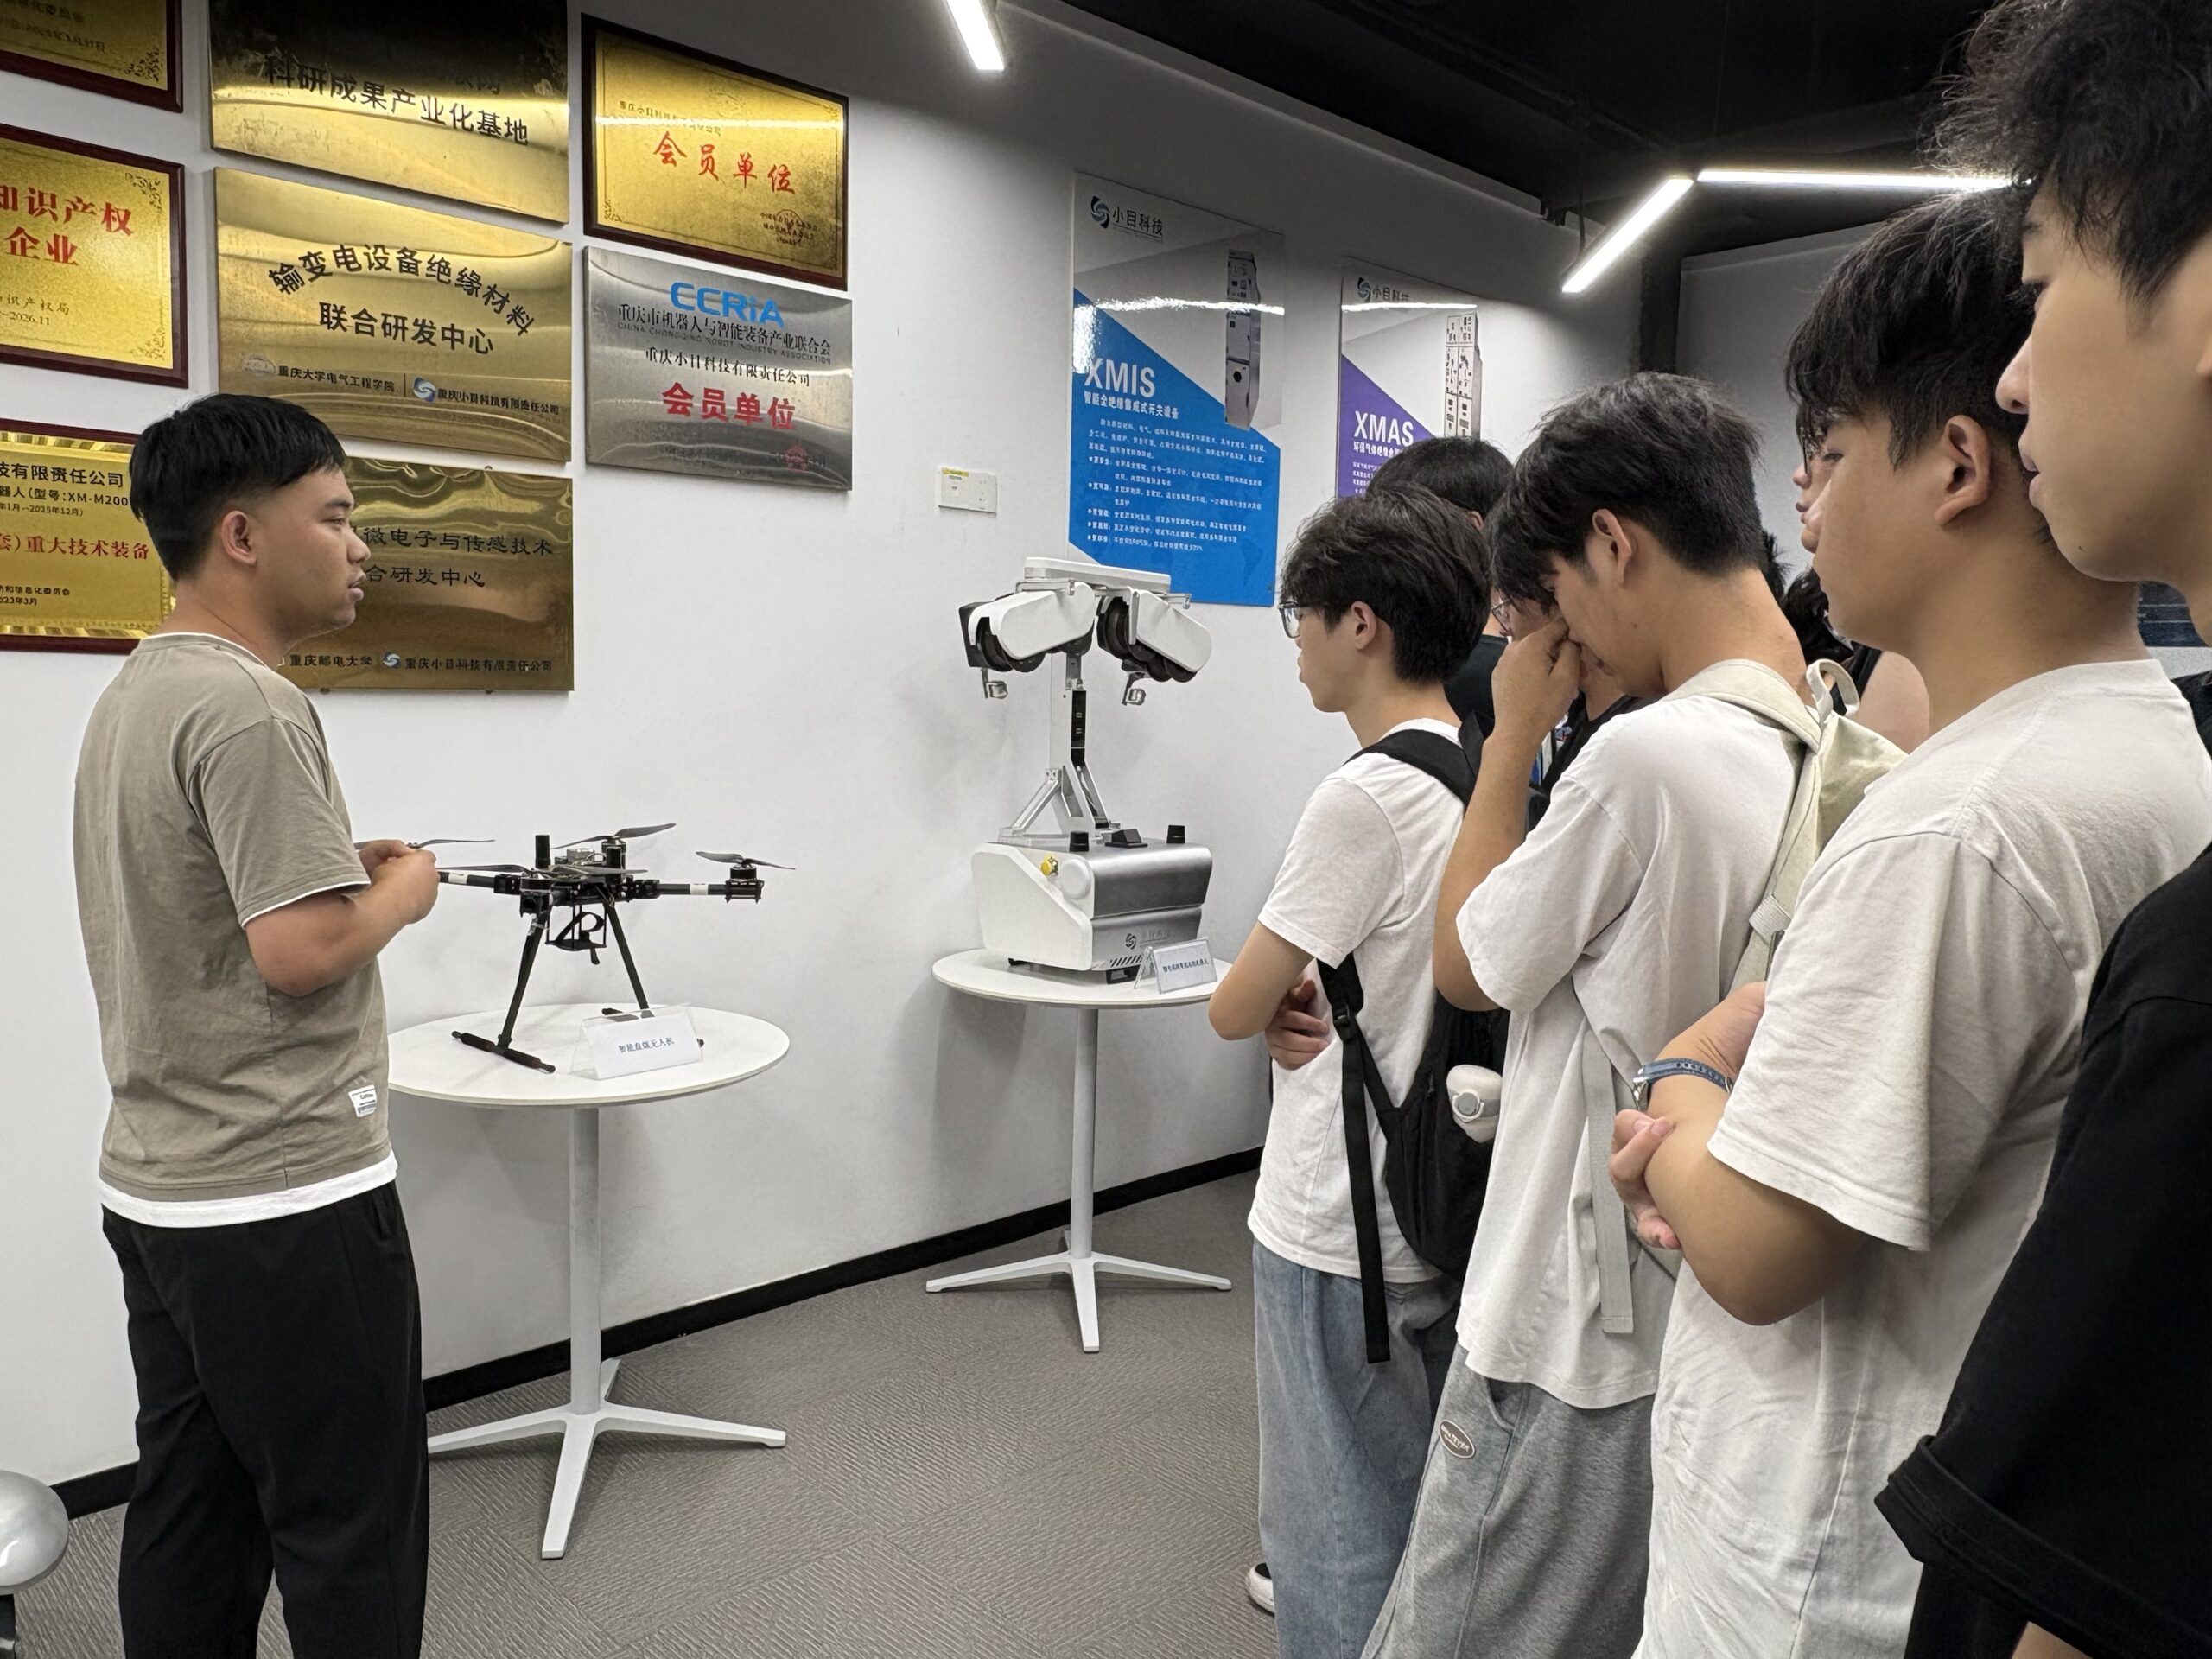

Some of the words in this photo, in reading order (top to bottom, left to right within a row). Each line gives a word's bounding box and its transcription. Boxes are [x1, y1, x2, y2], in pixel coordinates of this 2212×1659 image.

[262, 54, 529, 145] 科研成果产业化基地
[652, 130, 796, 194] 会员单位
[1112, 206, 1163, 237] 小目科技
[4, 226, 79, 266] 企业
[0, 294, 70, 316] 识产权局
[268, 243, 535, 336] 输变电设备绝缘材料
[318, 302, 494, 355] 联合研发中心
[617, 322, 645, 333] CHINA
[649, 327, 702, 343] CHONGQING
[780, 349, 831, 365] ASSOCIATION
[618, 303, 831, 356] 重庆市机器人与智能装备产业联合会
[278, 365, 395, 392] 重庆大学电气工程学院
[645, 346, 810, 387] 重庆小目科技有限责任公司
[1084, 357, 1156, 398] XMIS
[662, 381, 797, 429] 会员单位
[1353, 410, 1414, 447] XMAS
[349, 526, 553, 555] 微电子与传感技术
[289, 653, 372, 667] 重庆邮电大学
